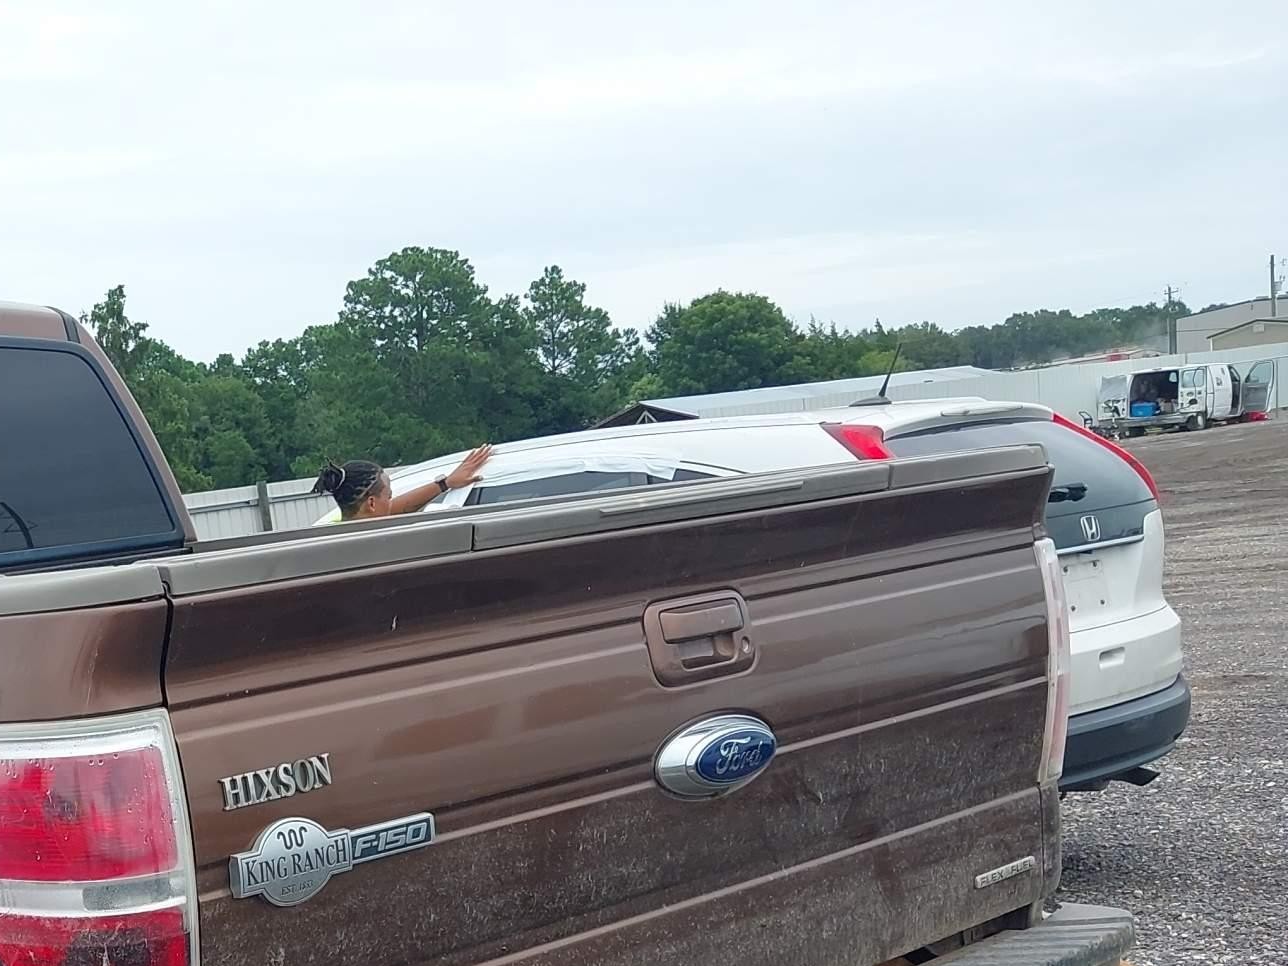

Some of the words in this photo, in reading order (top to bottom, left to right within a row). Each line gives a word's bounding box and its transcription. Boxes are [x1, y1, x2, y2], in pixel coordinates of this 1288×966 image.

[715, 736, 764, 775] Ford
[218, 752, 332, 811] HIXSON
[353, 821, 429, 858] F-150
[244, 856, 289, 887] KING
[292, 837, 349, 875] RANCH
